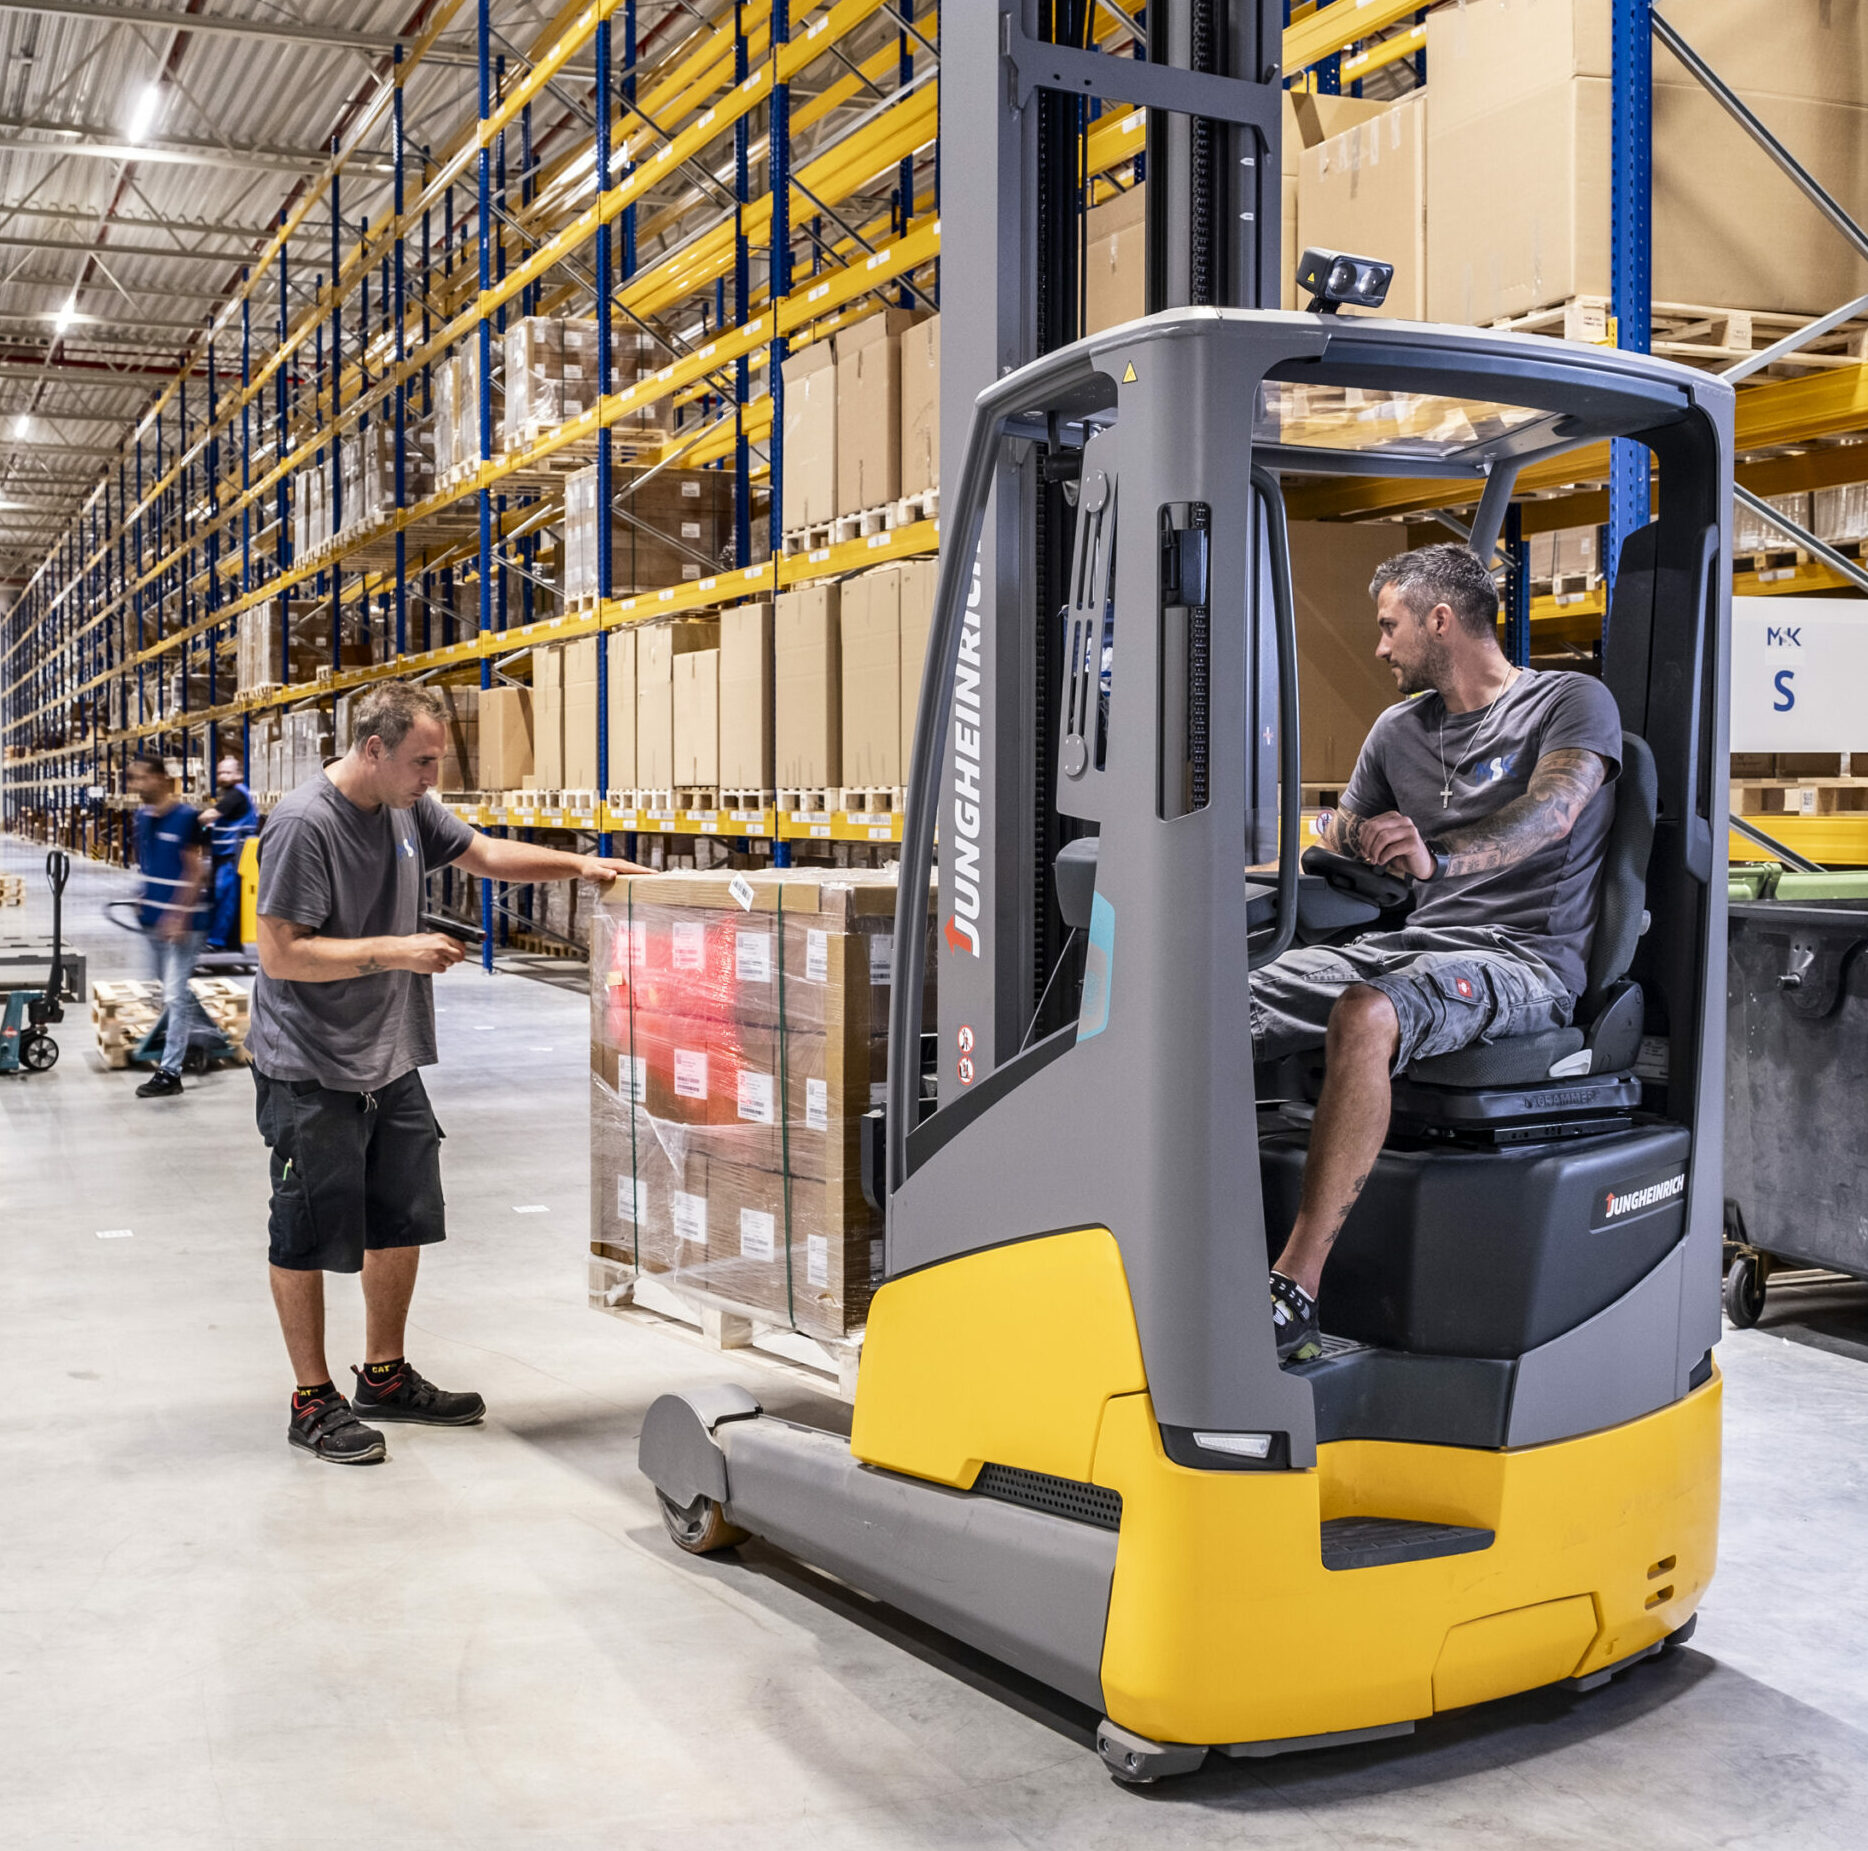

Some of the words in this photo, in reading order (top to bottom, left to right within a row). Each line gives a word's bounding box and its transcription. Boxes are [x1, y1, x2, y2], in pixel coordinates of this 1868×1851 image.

[1773, 669, 1795, 712] S
[953, 540, 982, 959] JUNGHEINRIC
[1605, 1173, 1685, 1218] JUNGHEINRICH
[371, 1365, 391, 1374] CAT
